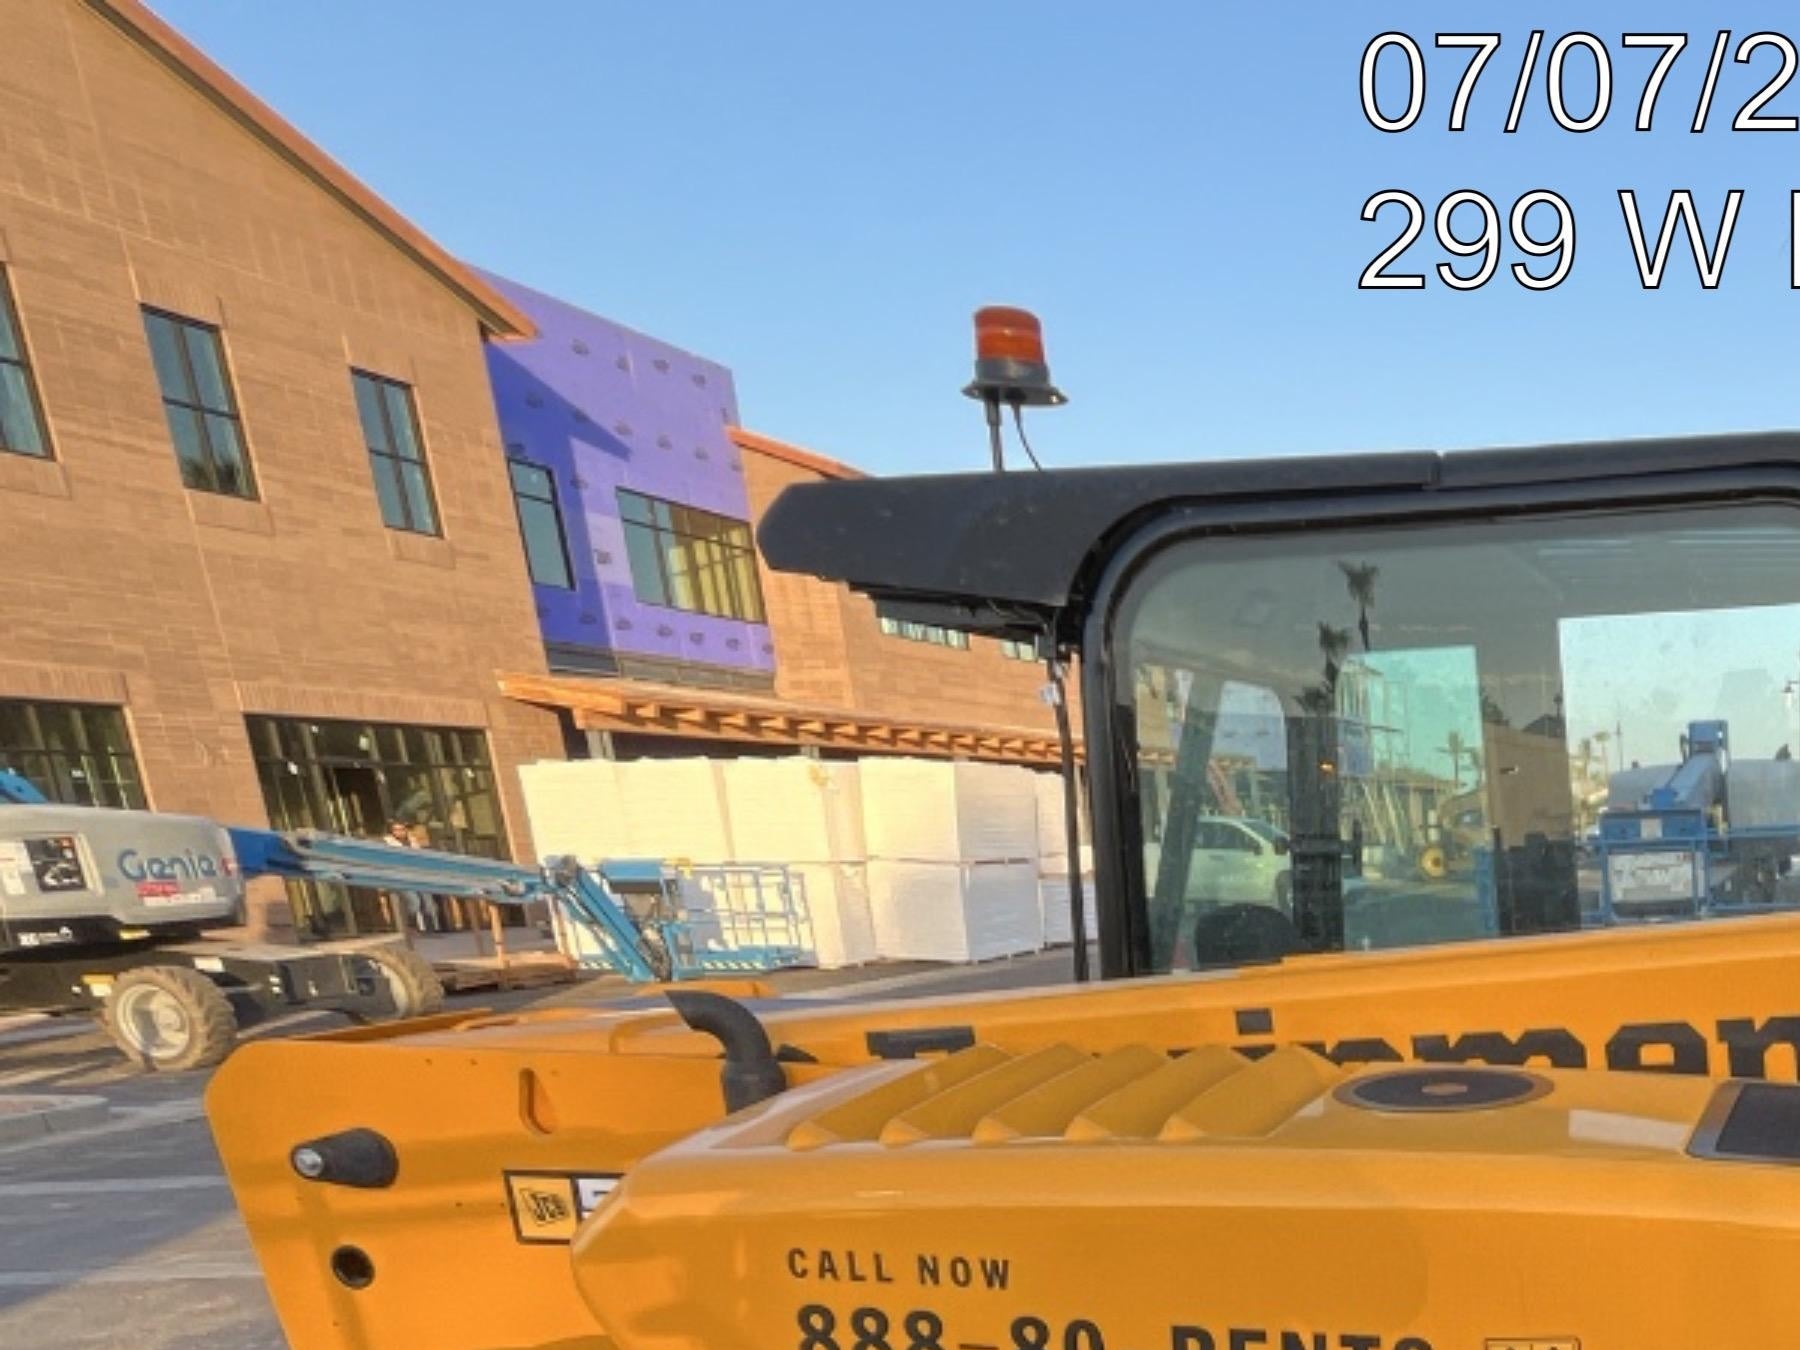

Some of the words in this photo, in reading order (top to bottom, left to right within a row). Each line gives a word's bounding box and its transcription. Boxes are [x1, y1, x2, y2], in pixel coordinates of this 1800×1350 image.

[117, 849, 217, 881] Genie
[788, 1248, 894, 1283] CALL
[918, 1255, 1010, 1291] NOW
